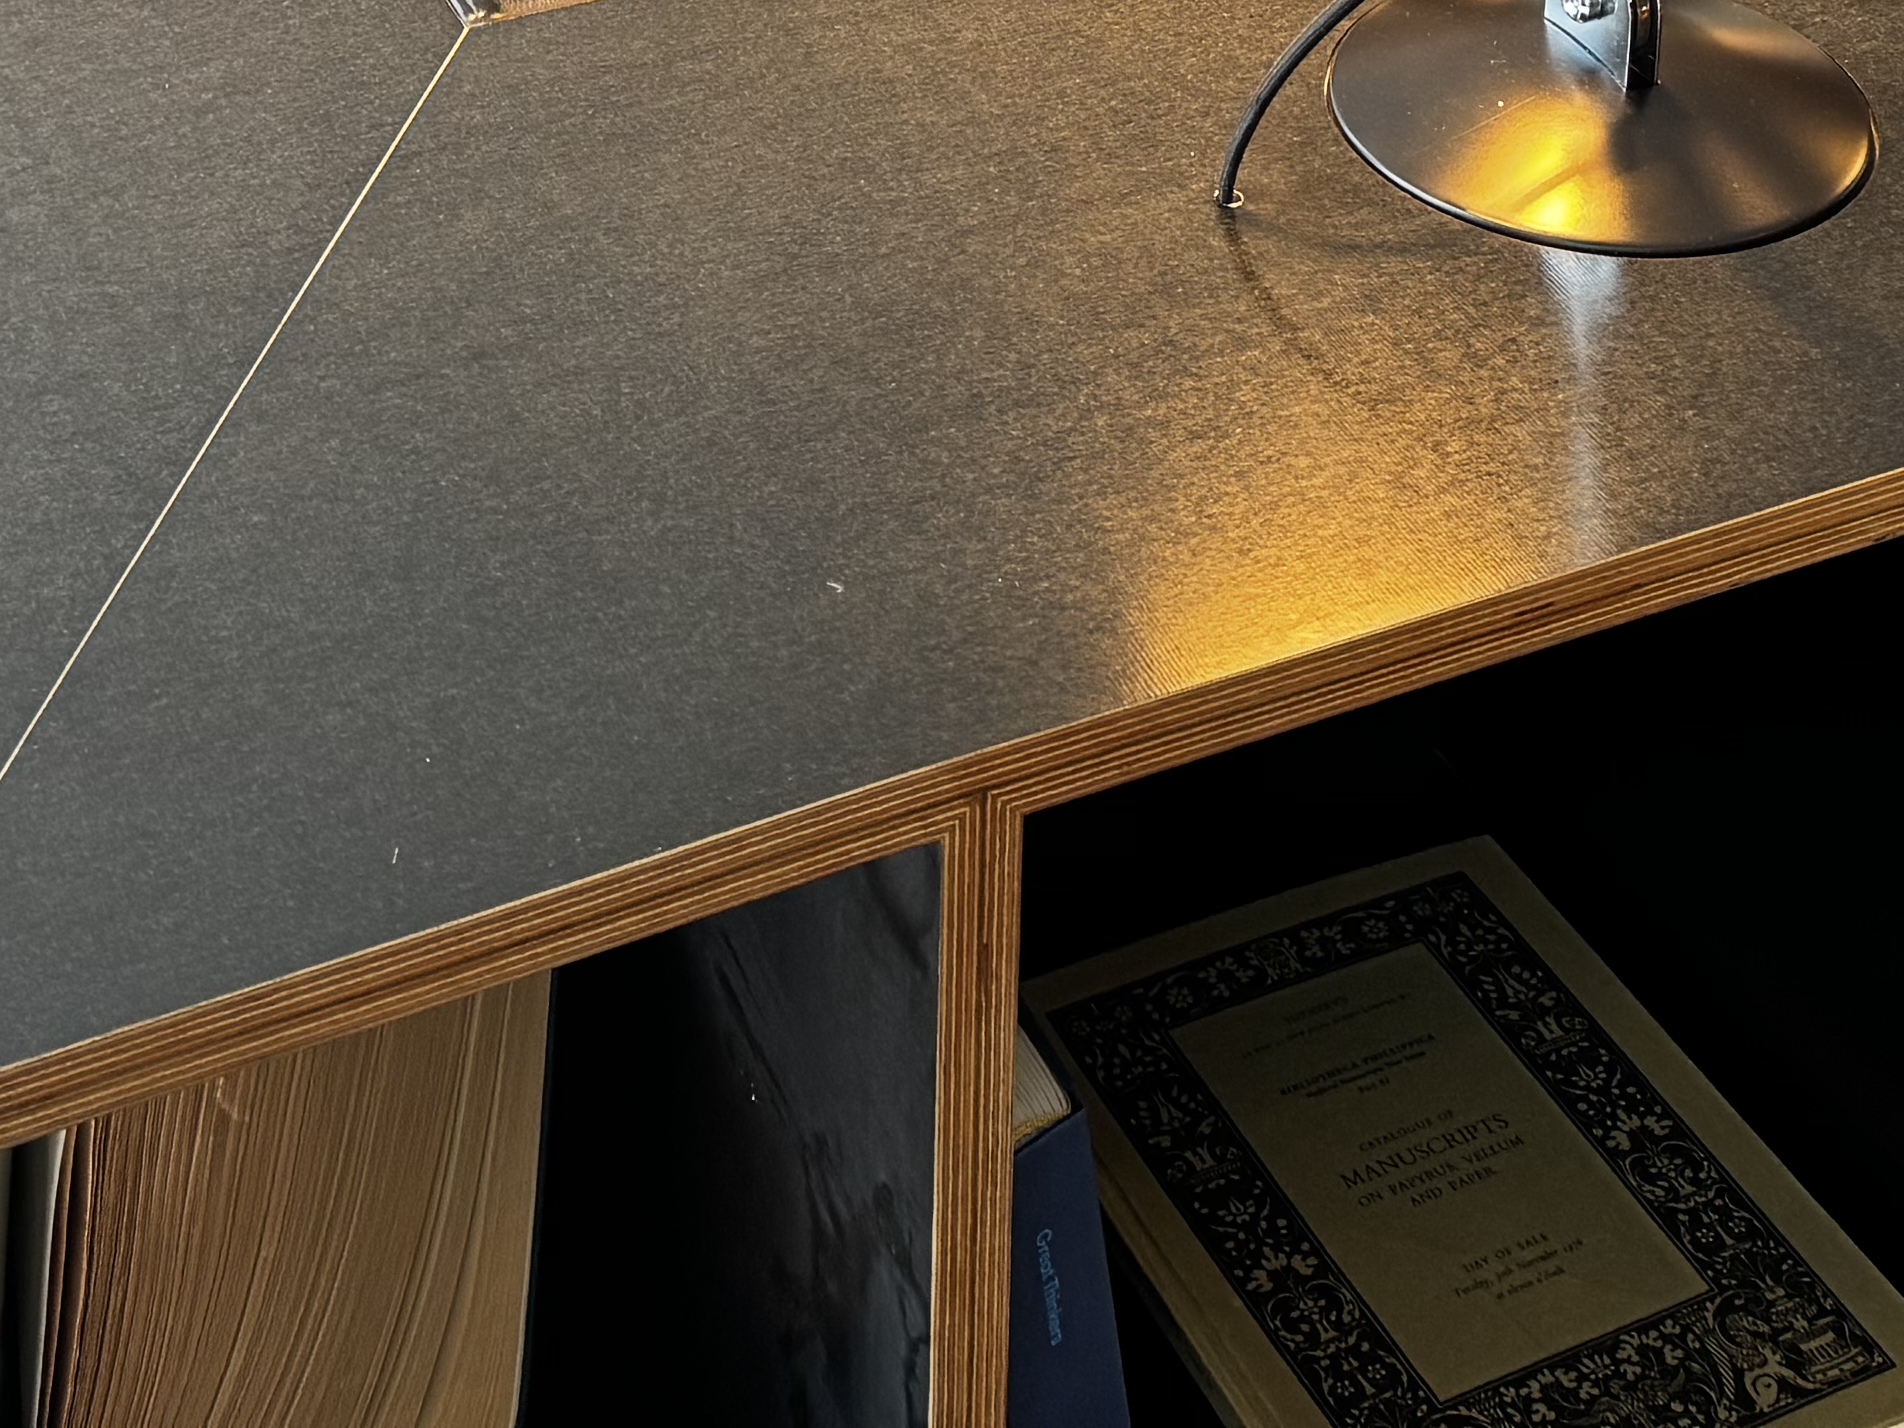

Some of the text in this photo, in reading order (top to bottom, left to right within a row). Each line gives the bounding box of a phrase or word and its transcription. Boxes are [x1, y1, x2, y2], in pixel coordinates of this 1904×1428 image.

[1341, 1113, 1509, 1190] MANUSCRIPTS
[1359, 1109, 1455, 1152] CATALOGUE OF
[1358, 1190, 1384, 1207] ON
[1461, 1134, 1525, 1165] VELLUM
[1410, 1165, 1497, 1207] AND PAPER
[1037, 1228, 1063, 1347] Great Thinkers
